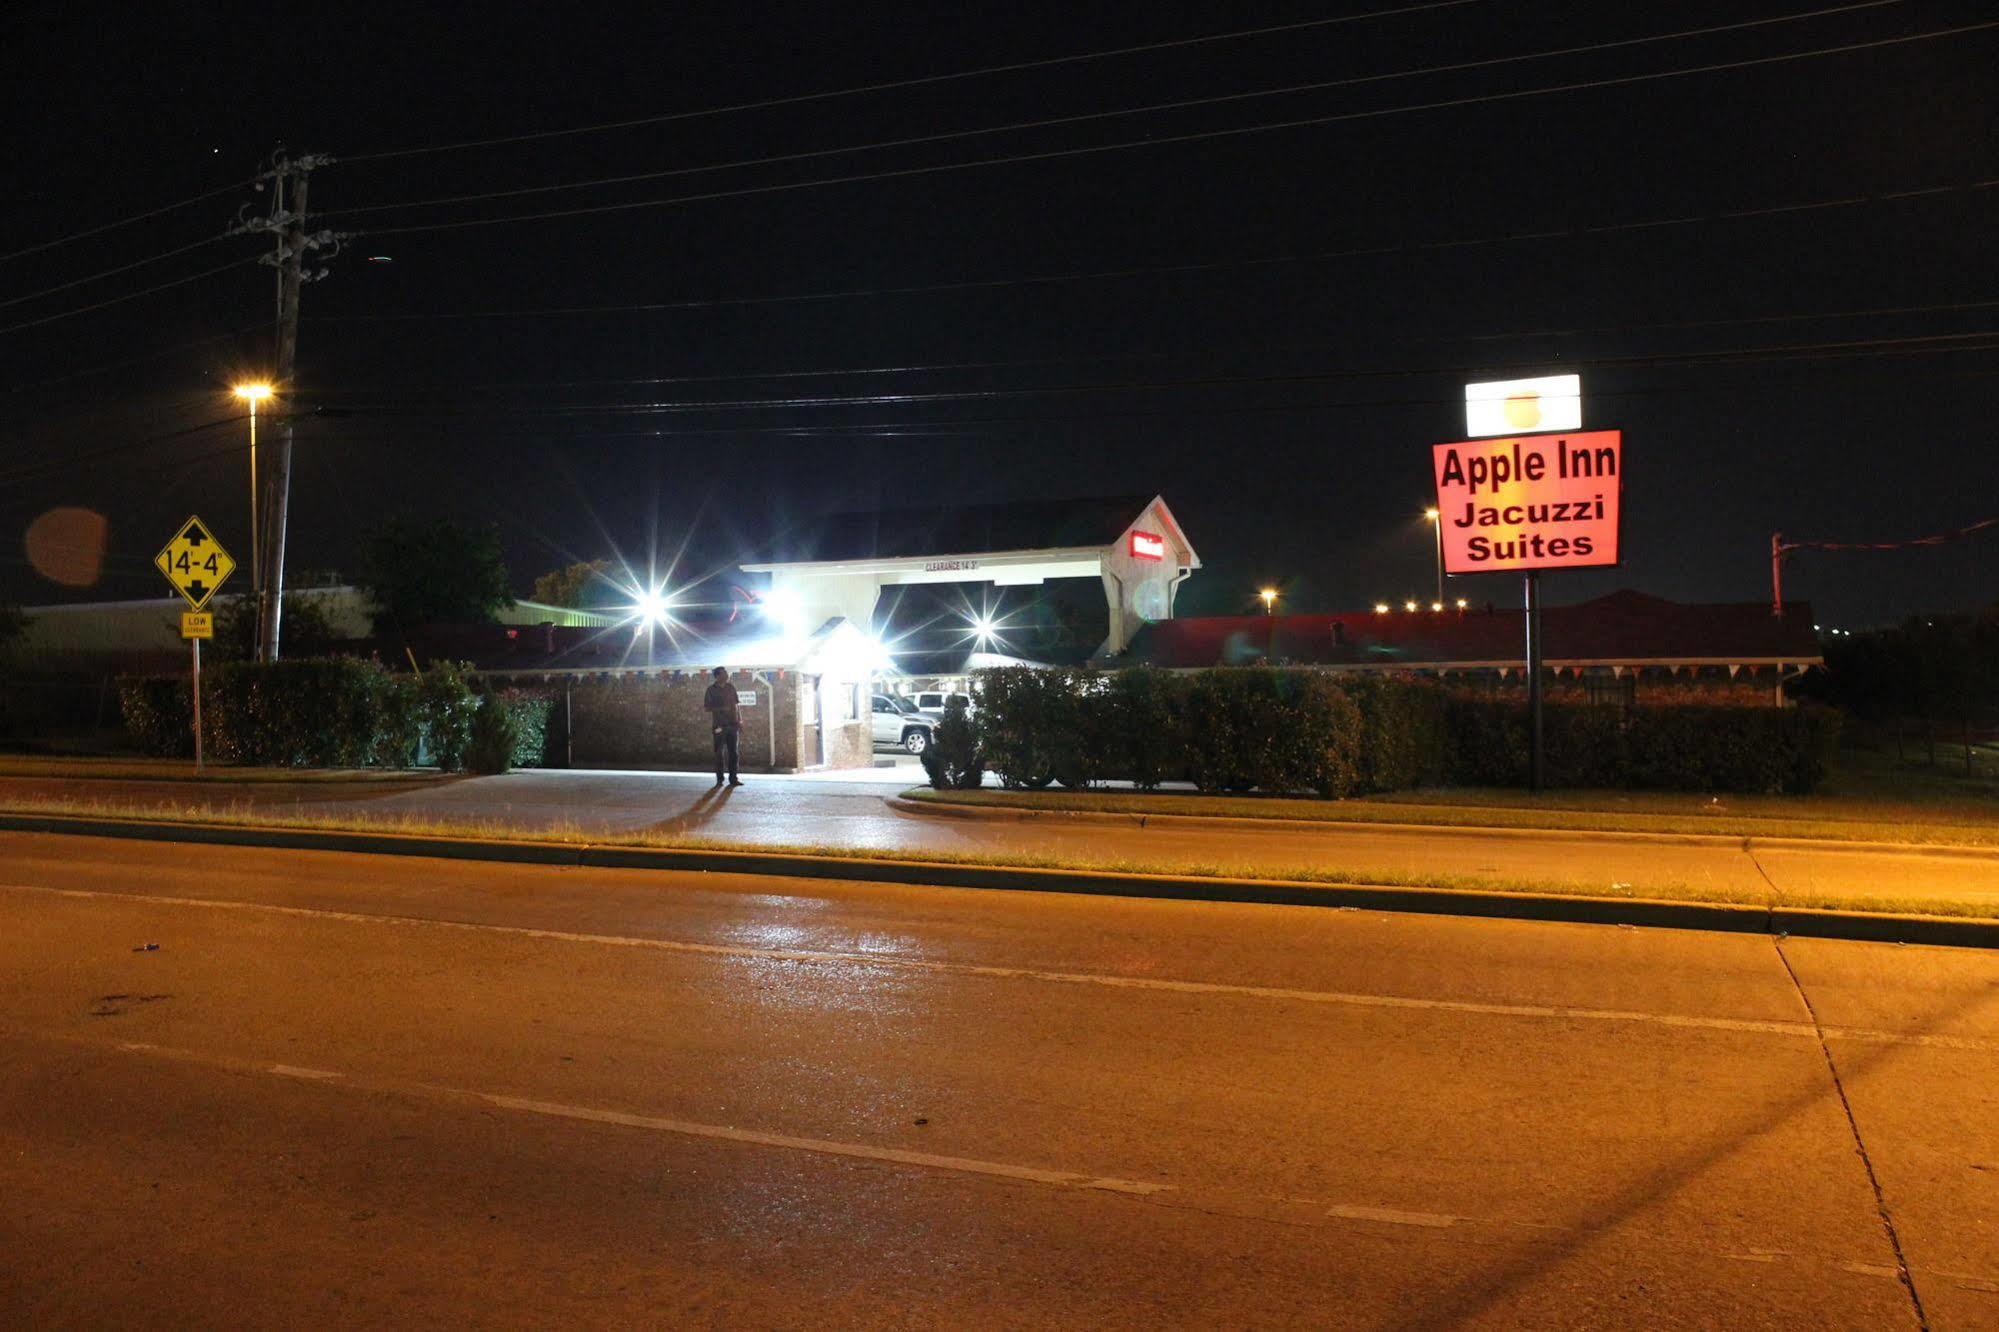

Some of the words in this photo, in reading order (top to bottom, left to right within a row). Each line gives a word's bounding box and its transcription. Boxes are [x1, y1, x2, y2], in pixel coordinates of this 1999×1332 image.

[1441, 443, 1545, 494] Apple
[1558, 440, 1616, 479] Inn
[1454, 494, 1604, 528] Jacuzzi
[1467, 533, 1593, 562] Suites
[926, 560, 960, 572] CLEARANCE
[188, 616, 207, 626] LOW
